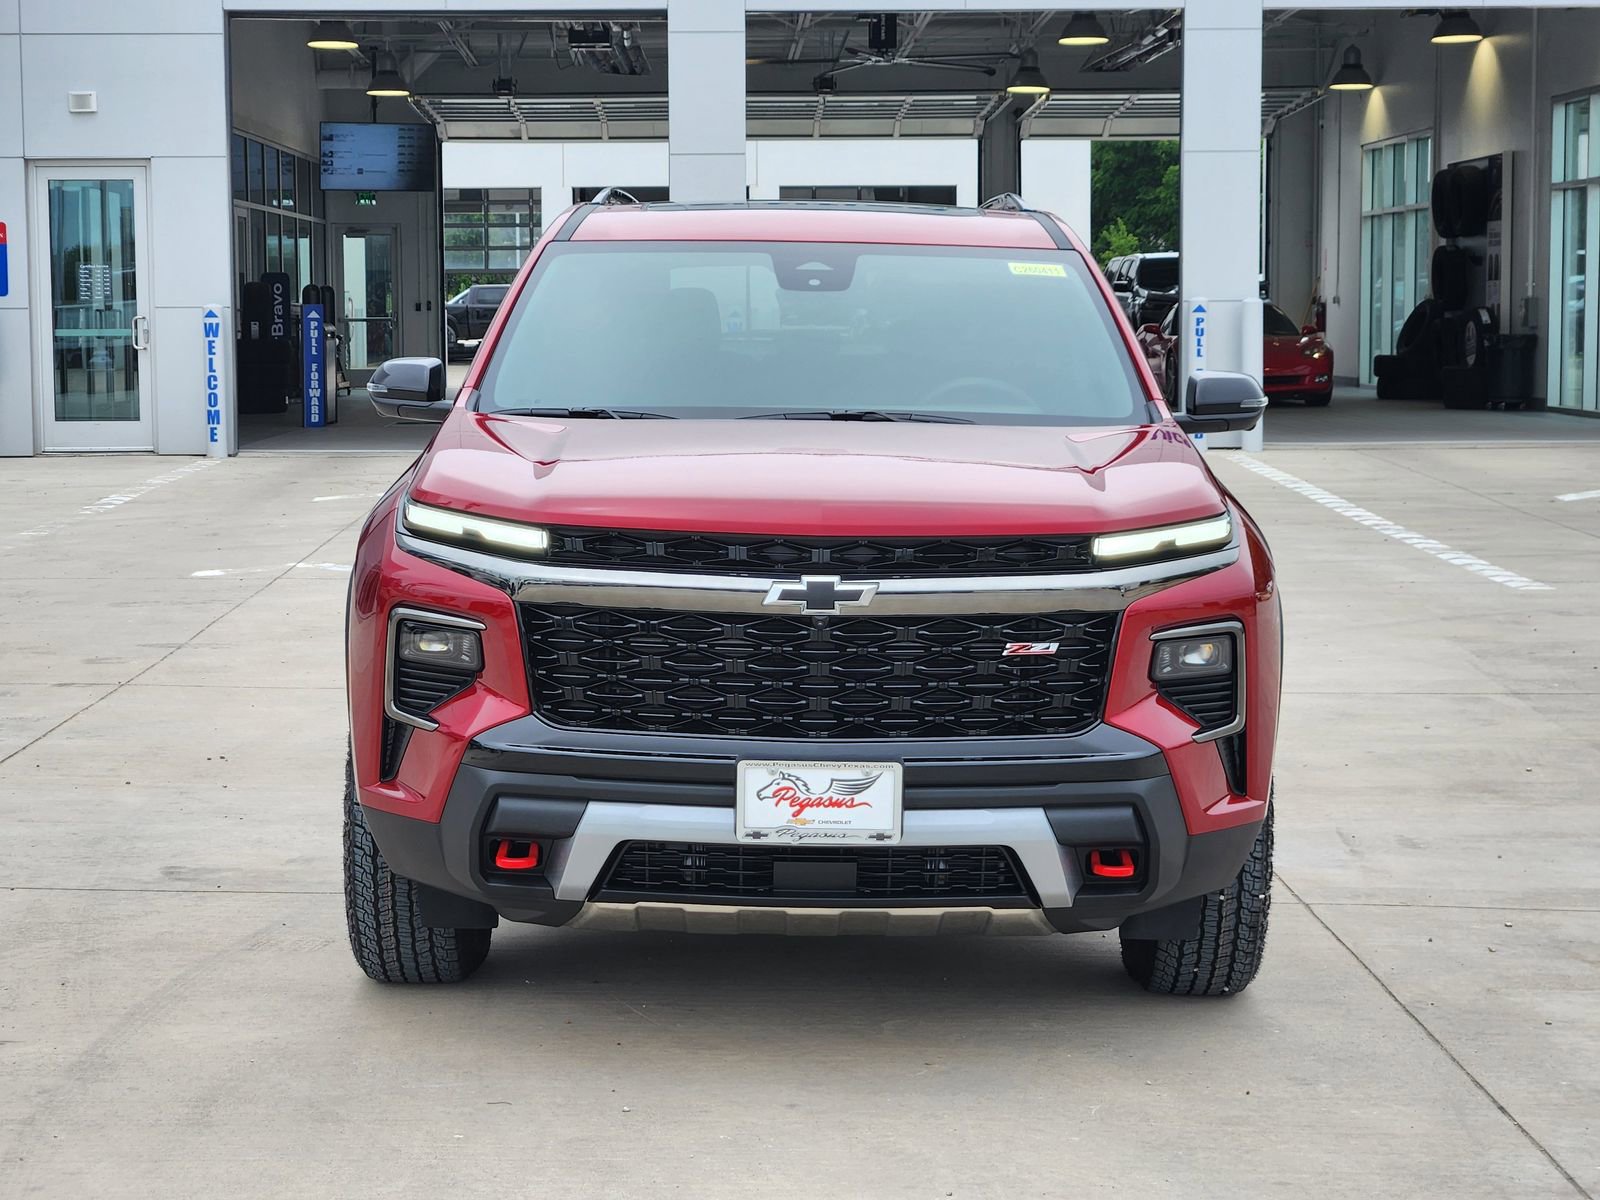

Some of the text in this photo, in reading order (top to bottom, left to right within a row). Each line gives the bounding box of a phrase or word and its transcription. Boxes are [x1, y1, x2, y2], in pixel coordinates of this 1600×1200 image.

[271, 282, 285, 336] Bravo
[1195, 317, 1205, 358] PULL
[203, 322, 220, 443] WELCOME
[308, 320, 321, 423] PULL FORWARD
[745, 761, 894, 770] www.PegasusChevyTexas.com
[772, 785, 873, 818] Pegasus
[775, 828, 862, 842] Pegasus
